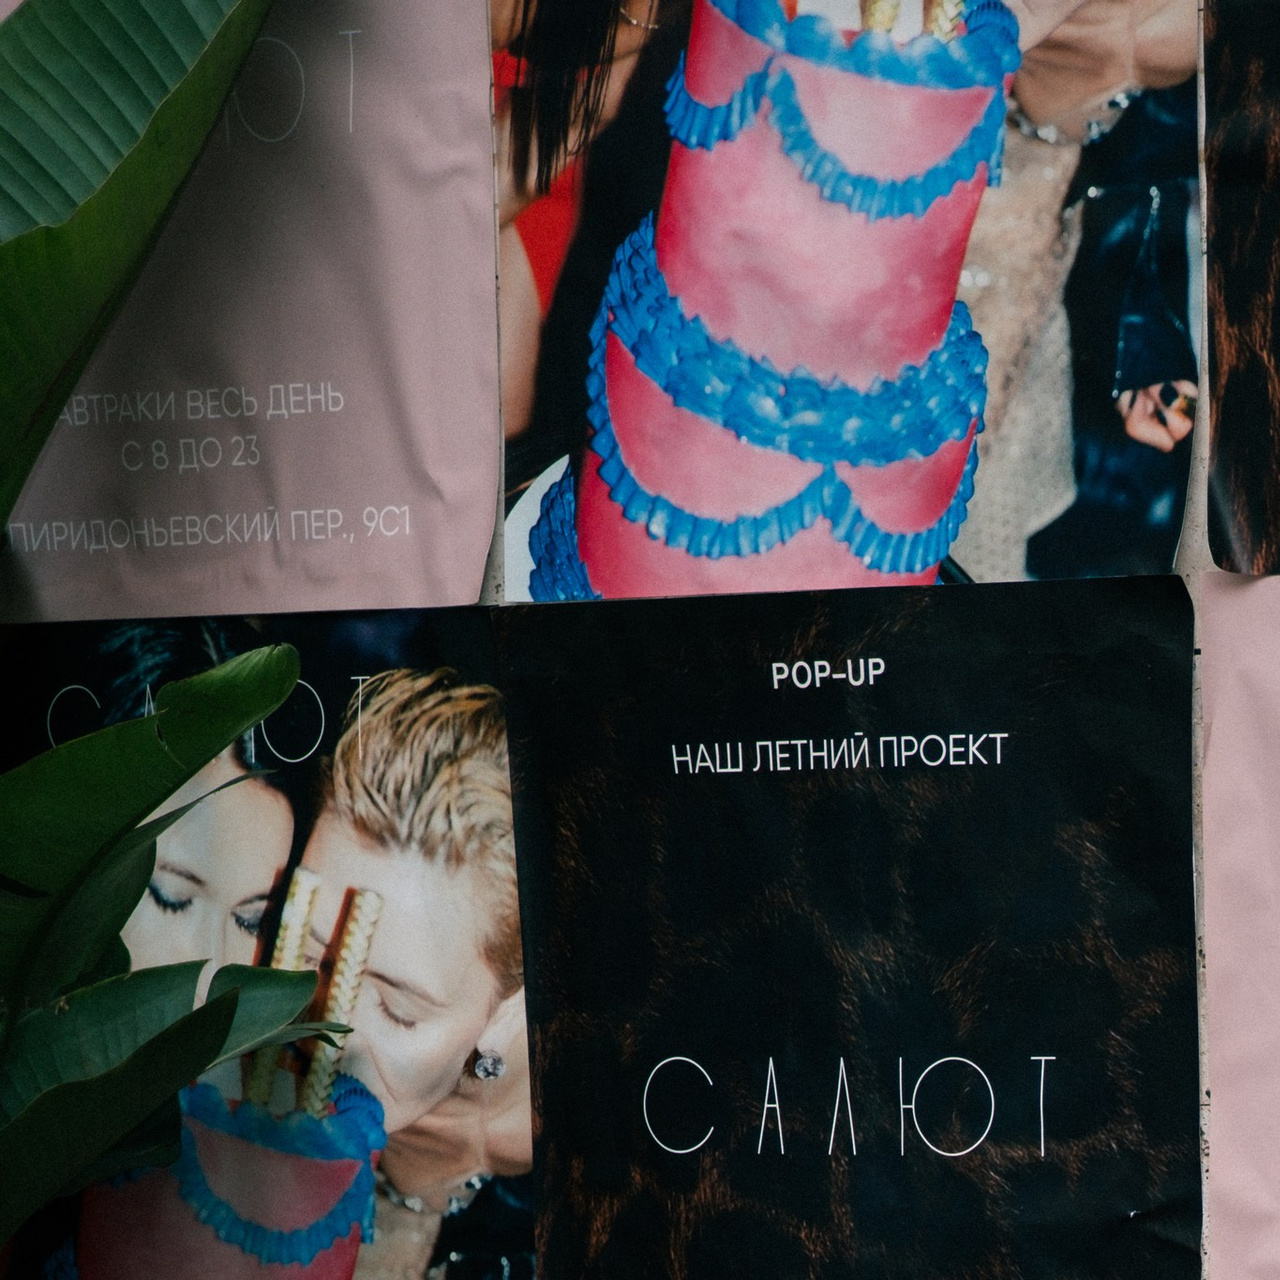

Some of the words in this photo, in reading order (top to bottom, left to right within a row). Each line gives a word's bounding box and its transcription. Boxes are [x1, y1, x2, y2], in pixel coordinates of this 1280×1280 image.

[59, 392, 175, 425] ВТРАКИ
[187, 387, 258, 419] ВЕСЬ
[267, 383, 344, 418] ДЕНЬ
[122, 441, 143, 471] С
[152, 440, 169, 469] 8
[179, 437, 222, 473] ДО
[231, 436, 259, 466] 23
[8, 507, 280, 554] ПИРИДОНЬЕВСКИЙ
[291, 509, 354, 543] ПЕР.,
[363, 505, 410, 536] 9С1
[772, 658, 885, 689] POP-UP
[672, 743, 743, 773] НАШ
[753, 732, 869, 771] ЛЕТНИЙ
[880, 733, 1008, 767] ПРОЕКТ
[643, 1056, 1056, 1157] САЛЮТ
